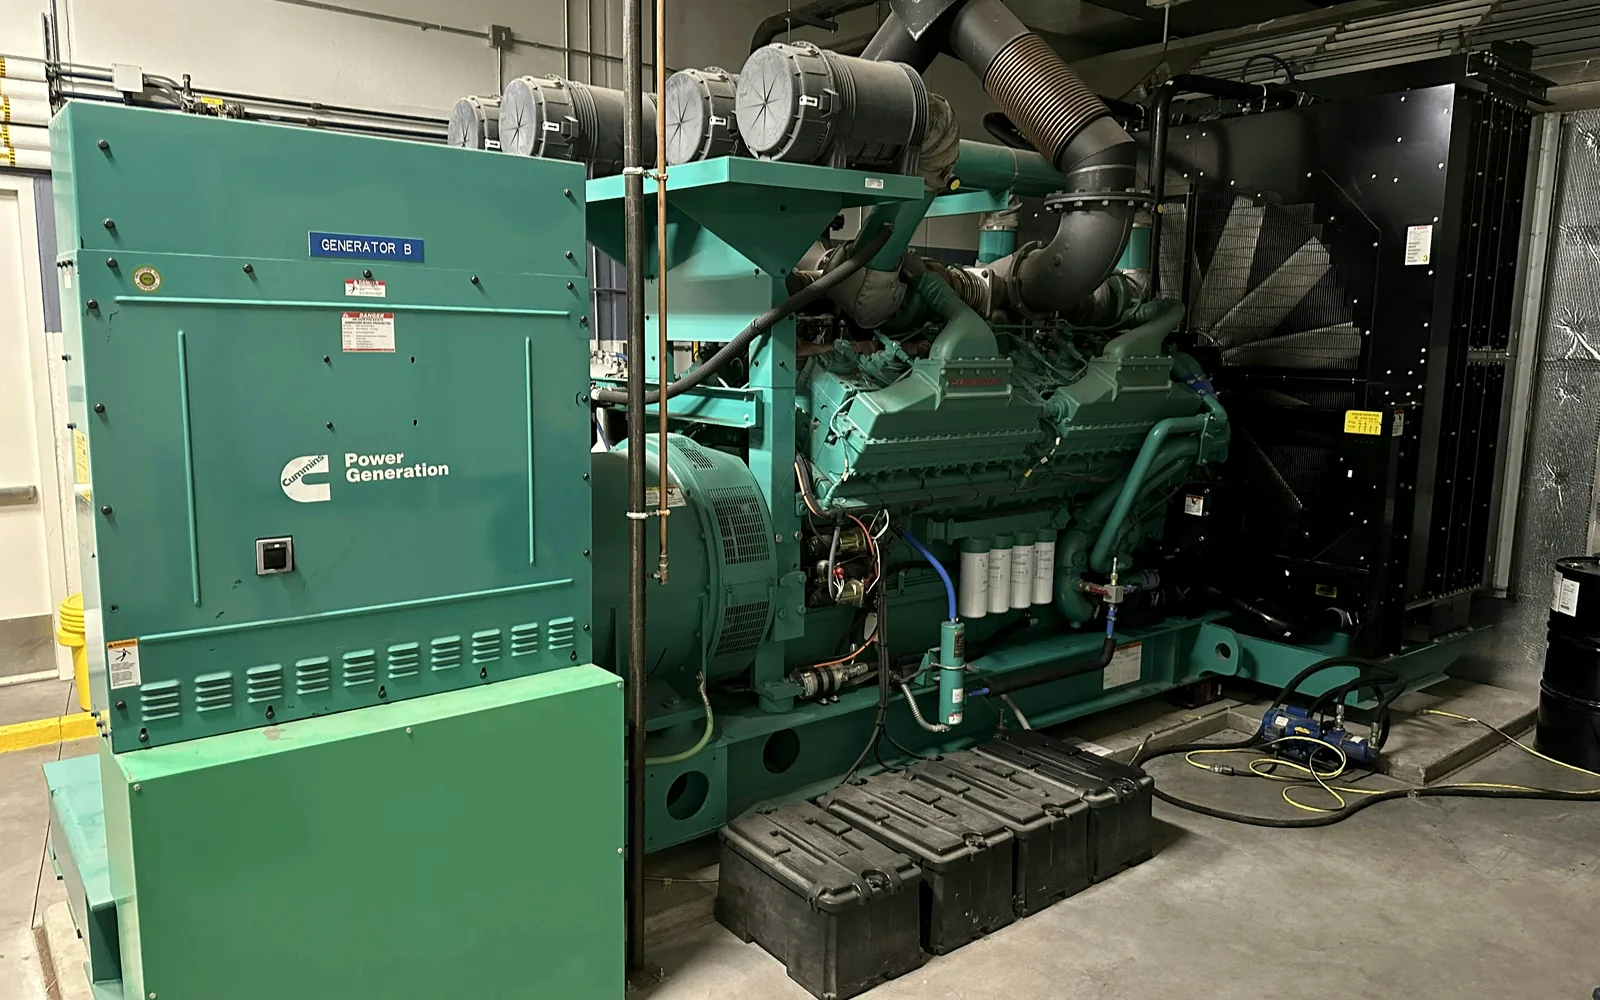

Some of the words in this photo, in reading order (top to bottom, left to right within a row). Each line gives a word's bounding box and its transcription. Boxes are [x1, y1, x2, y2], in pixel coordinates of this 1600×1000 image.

[321, 238, 396, 254] GENERATOR
[403, 243, 412, 255] B
[344, 452, 404, 468] Power
[282, 455, 325, 487] Cummins
[345, 463, 449, 483] Generation
